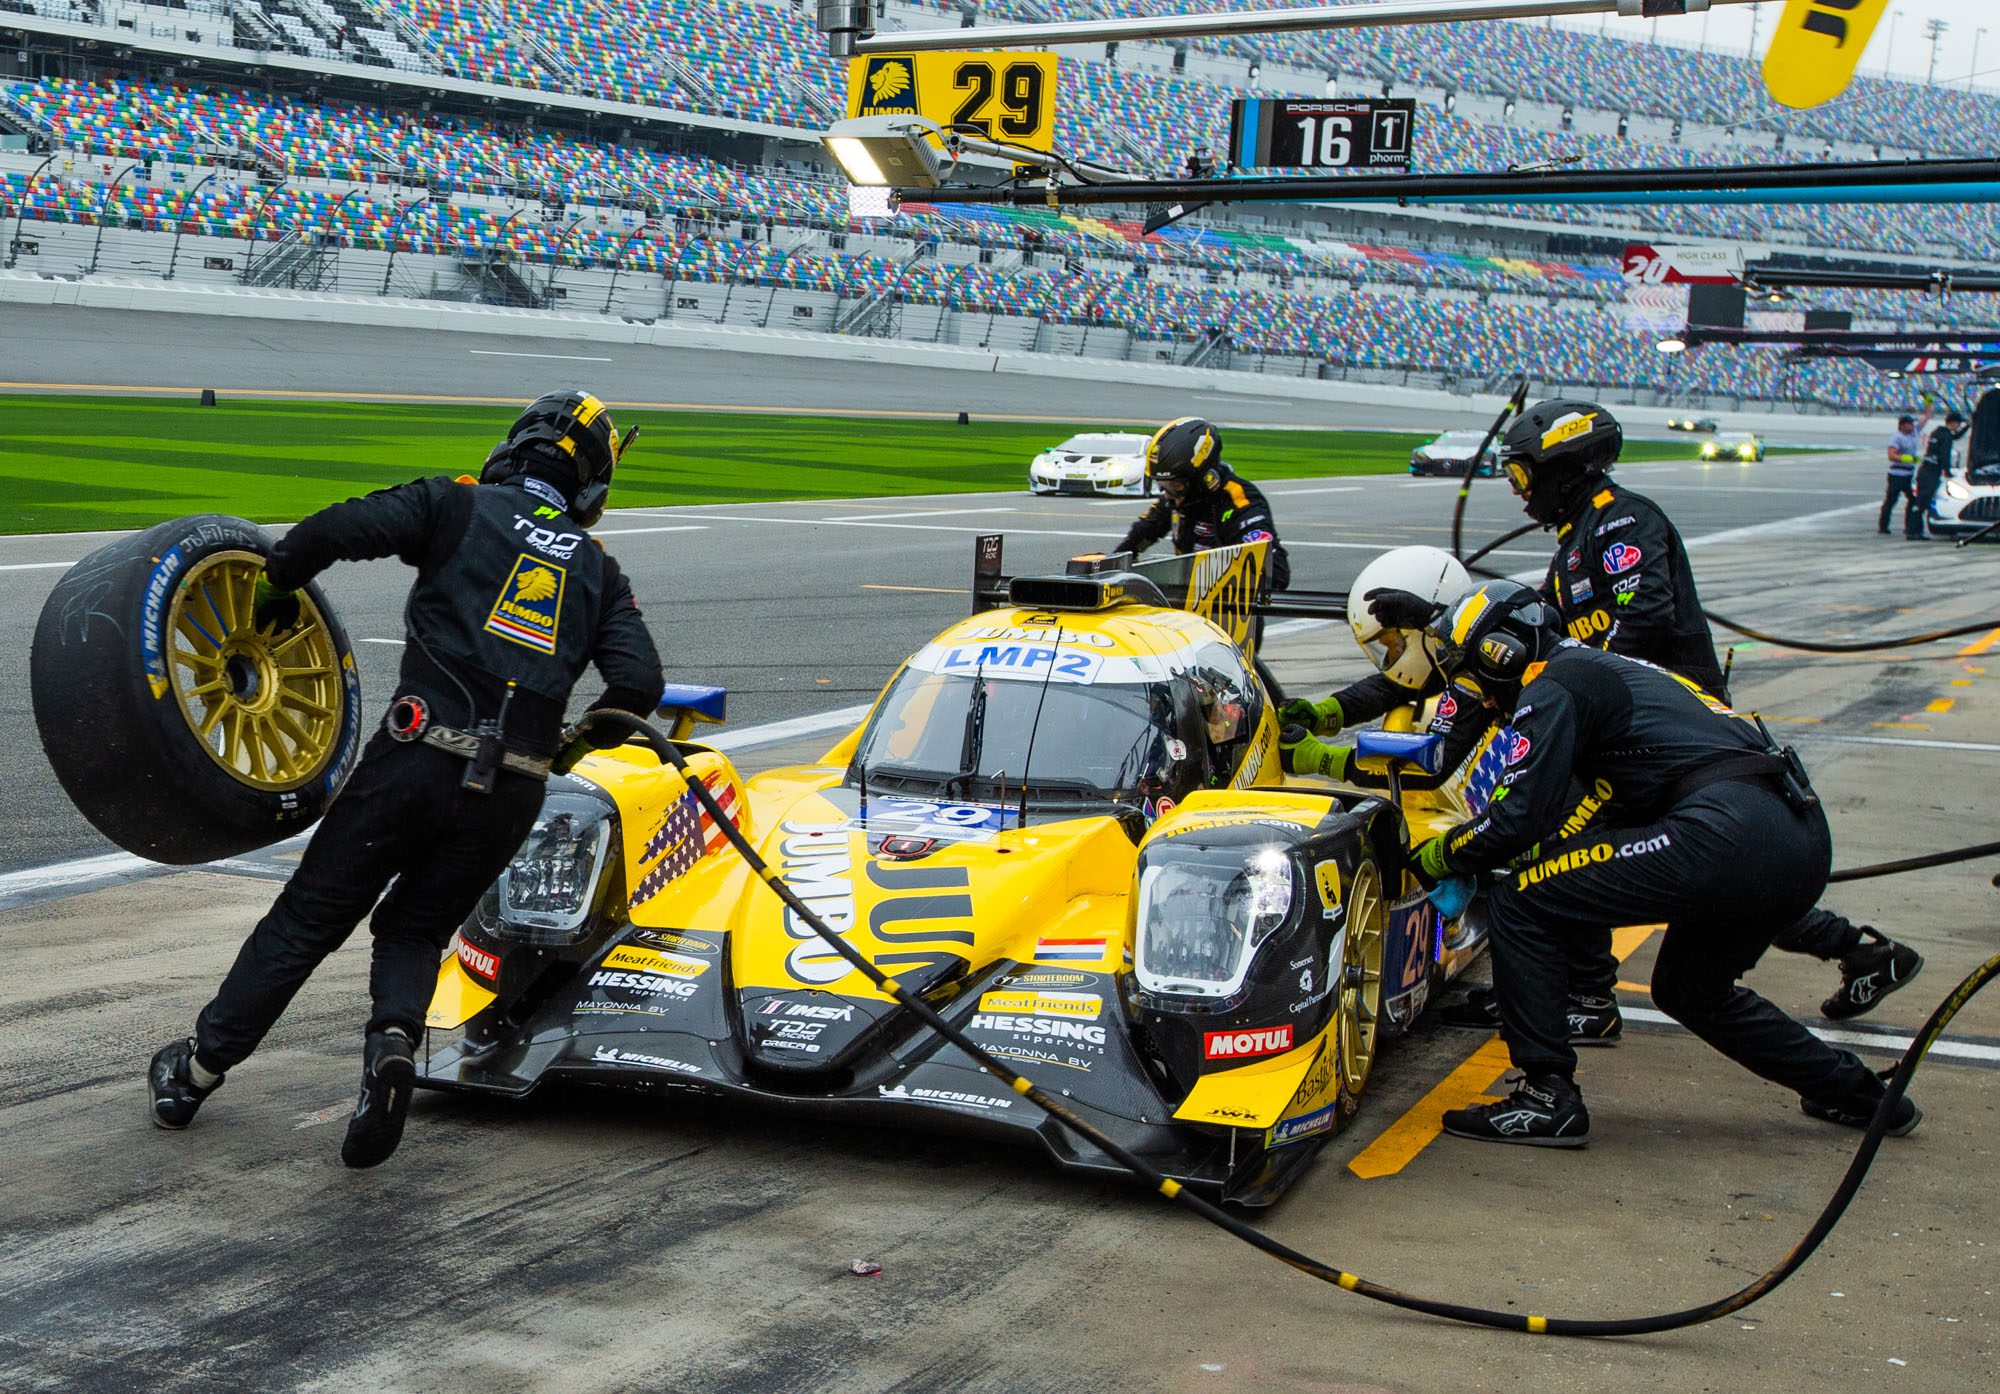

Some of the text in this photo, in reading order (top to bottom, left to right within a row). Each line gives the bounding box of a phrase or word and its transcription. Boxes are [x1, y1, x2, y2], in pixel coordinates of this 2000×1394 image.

[951, 61, 1045, 138] 29
[1286, 104, 1370, 112] PORSCHE
[1297, 116, 1352, 166] 16
[1700, 252, 1727, 260] CLASS
[1623, 255, 1668, 284] 20
[513, 514, 583, 551] TDS
[1607, 516, 1636, 531] IMSA
[1603, 543, 1626, 572] VP
[144, 553, 180, 652] MICHELIN
[500, 600, 553, 627] JUMBO
[953, 627, 1116, 648] JUMBO
[944, 646, 1092, 677] LMP2
[872, 802, 993, 826] 29
[1517, 833, 1671, 892] JUMBO.com
[780, 820, 859, 985] JUMBO
[458, 938, 495, 977] MOTUL
[1402, 902, 1429, 988] 29
[1290, 955, 1314, 971] Somerset
[587, 971, 699, 997] HESSING
[629, 988, 689, 1002] supervers
[575, 1000, 670, 1014] MAYONNA BV
[785, 1004, 853, 1022] IMSA
[768, 1018, 828, 1035] TDS
[776, 1032, 817, 1041] RACING
[971, 1014, 1106, 1045] HESSING
[760, 1039, 806, 1051] ORECA
[973, 1042, 1059, 1062] MAYONNA
[1068, 1056, 1092, 1068] BV
[1013, 1033, 1105, 1055] supervers
[1209, 1029, 1290, 1056] MOTUL
[619, 1052, 702, 1073] MICHELIN
[911, 1088, 1013, 1109] MICHELIN
[1290, 1111, 1331, 1135] MICHELIN
